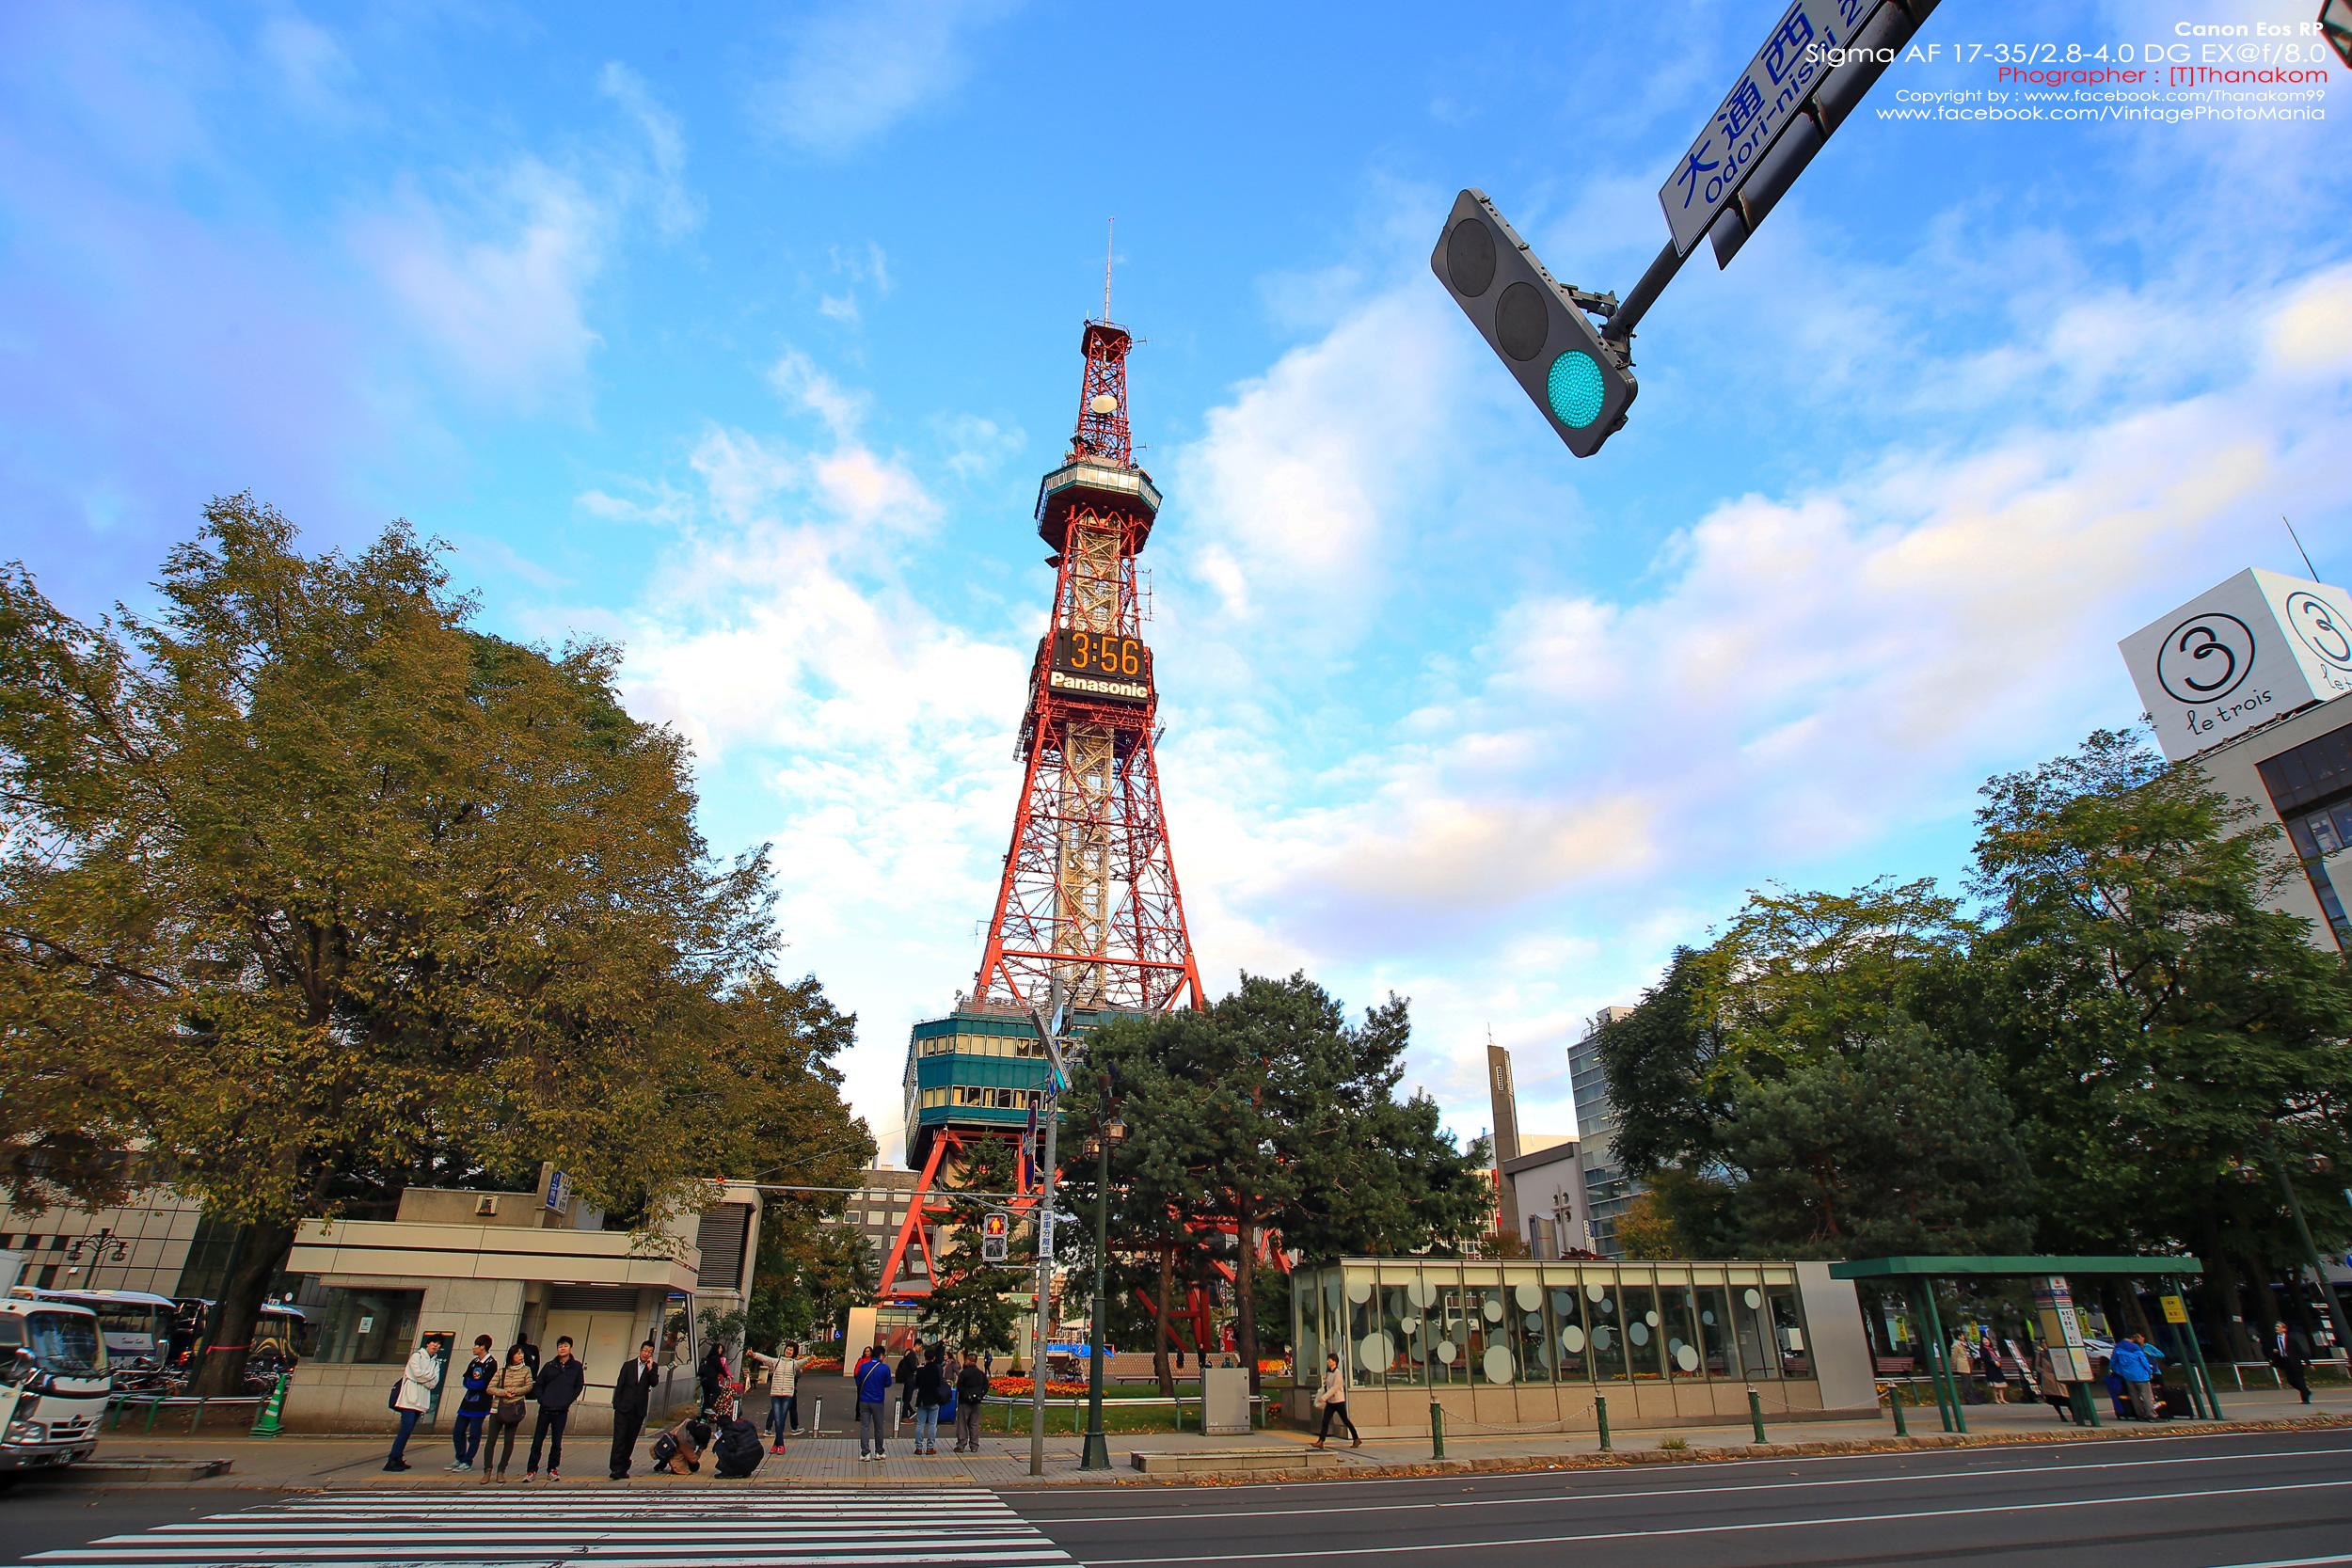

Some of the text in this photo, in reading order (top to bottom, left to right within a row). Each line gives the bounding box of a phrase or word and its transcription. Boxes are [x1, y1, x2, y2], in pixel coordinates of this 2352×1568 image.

[1677, 1, 1814, 209] 大通西
[1705, 25, 1837, 203] Odori-nishi
[1071, 632, 1139, 675] 3:56
[1050, 671, 1148, 698] Panasonic
[1041, 1212, 1052, 1256] 歩車分離式
